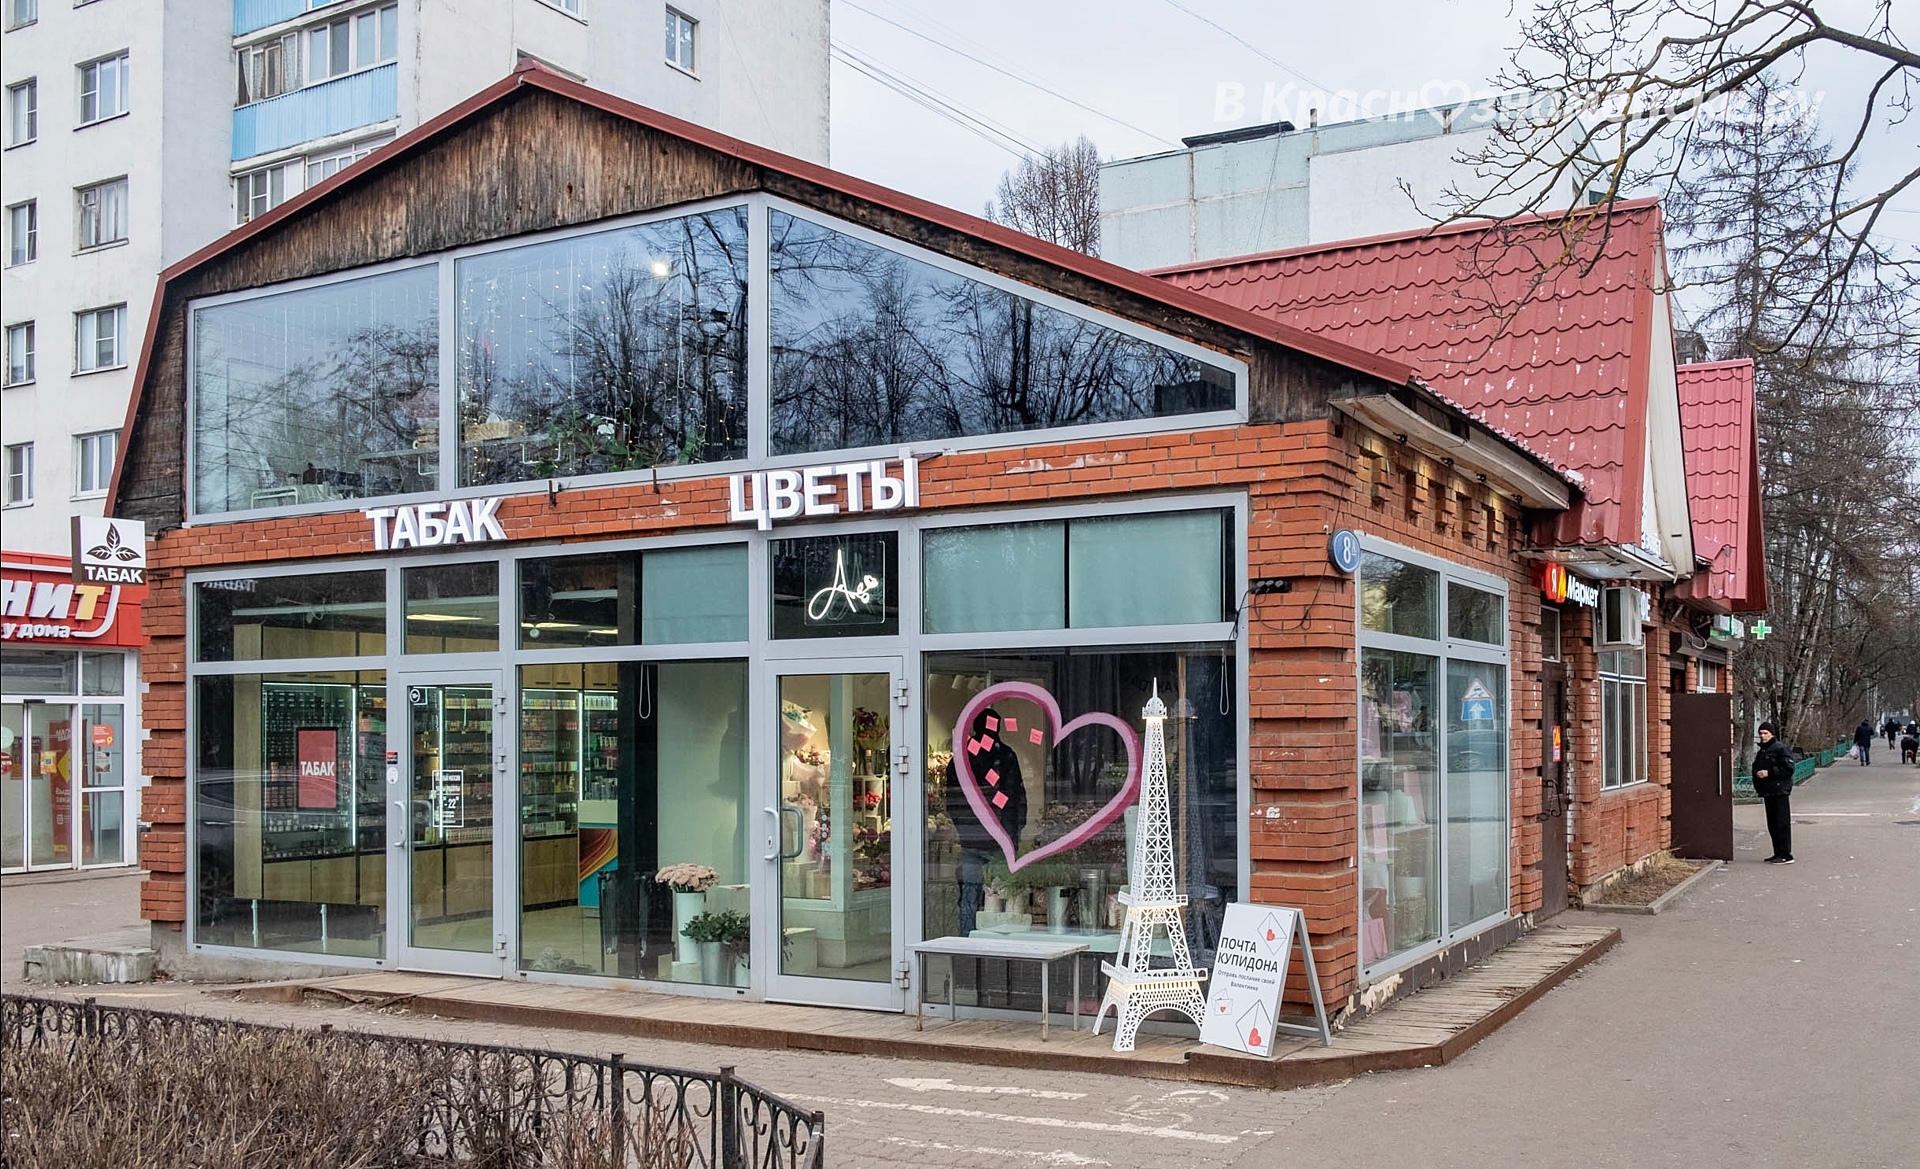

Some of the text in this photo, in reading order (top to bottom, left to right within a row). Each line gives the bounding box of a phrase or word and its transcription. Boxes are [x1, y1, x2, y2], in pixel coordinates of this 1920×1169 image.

[729, 457, 919, 531] ЦВЕТЫ
[366, 497, 508, 550] ТАБАК
[84, 565, 144, 583] ТАБАК
[1566, 574, 1599, 608] Маркет
[16, 623, 70, 638] дома
[300, 760, 336, 777] ТАБАК
[1220, 937, 1257, 954] ПОЧТА
[1217, 952, 1278, 974] КУПИДОНА
